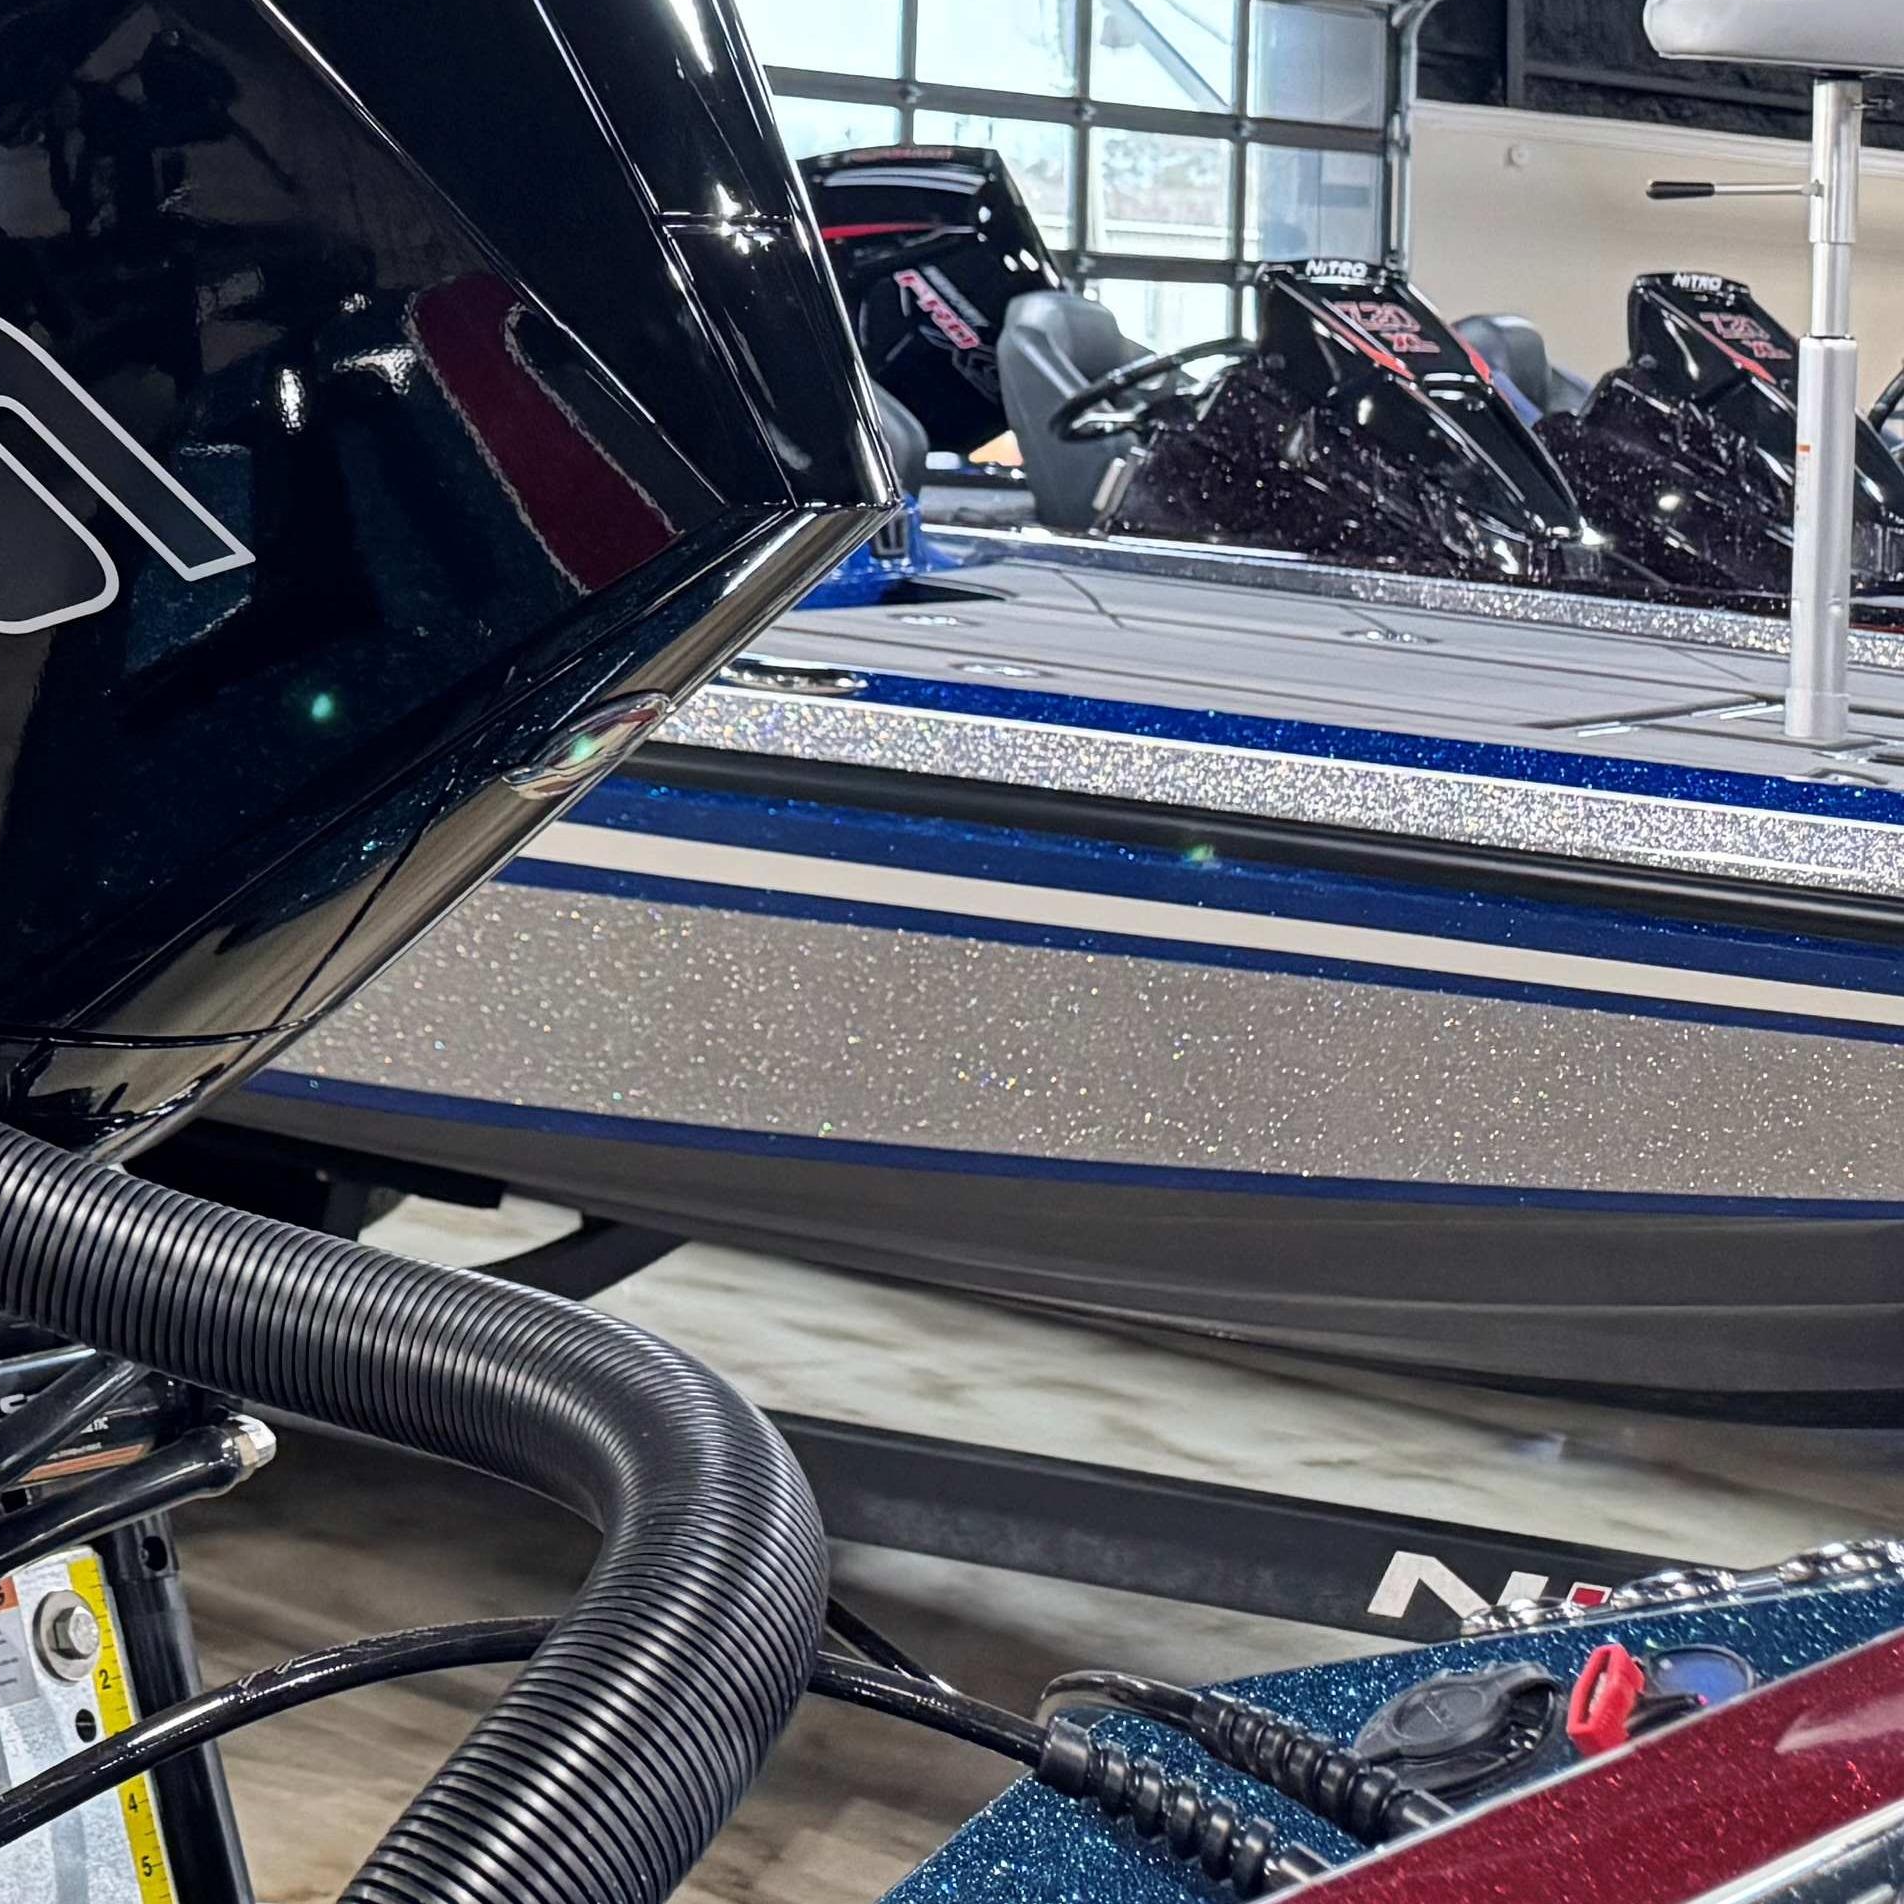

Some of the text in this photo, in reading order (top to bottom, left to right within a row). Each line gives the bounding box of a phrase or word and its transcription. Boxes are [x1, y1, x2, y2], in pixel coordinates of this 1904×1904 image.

[1305, 259, 1368, 278] NITRO
[1672, 272, 1723, 291] NITRO
[99, 1669, 111, 1690] 2
[128, 1793, 138, 1813] 4
[141, 1856, 153, 1878] 5
